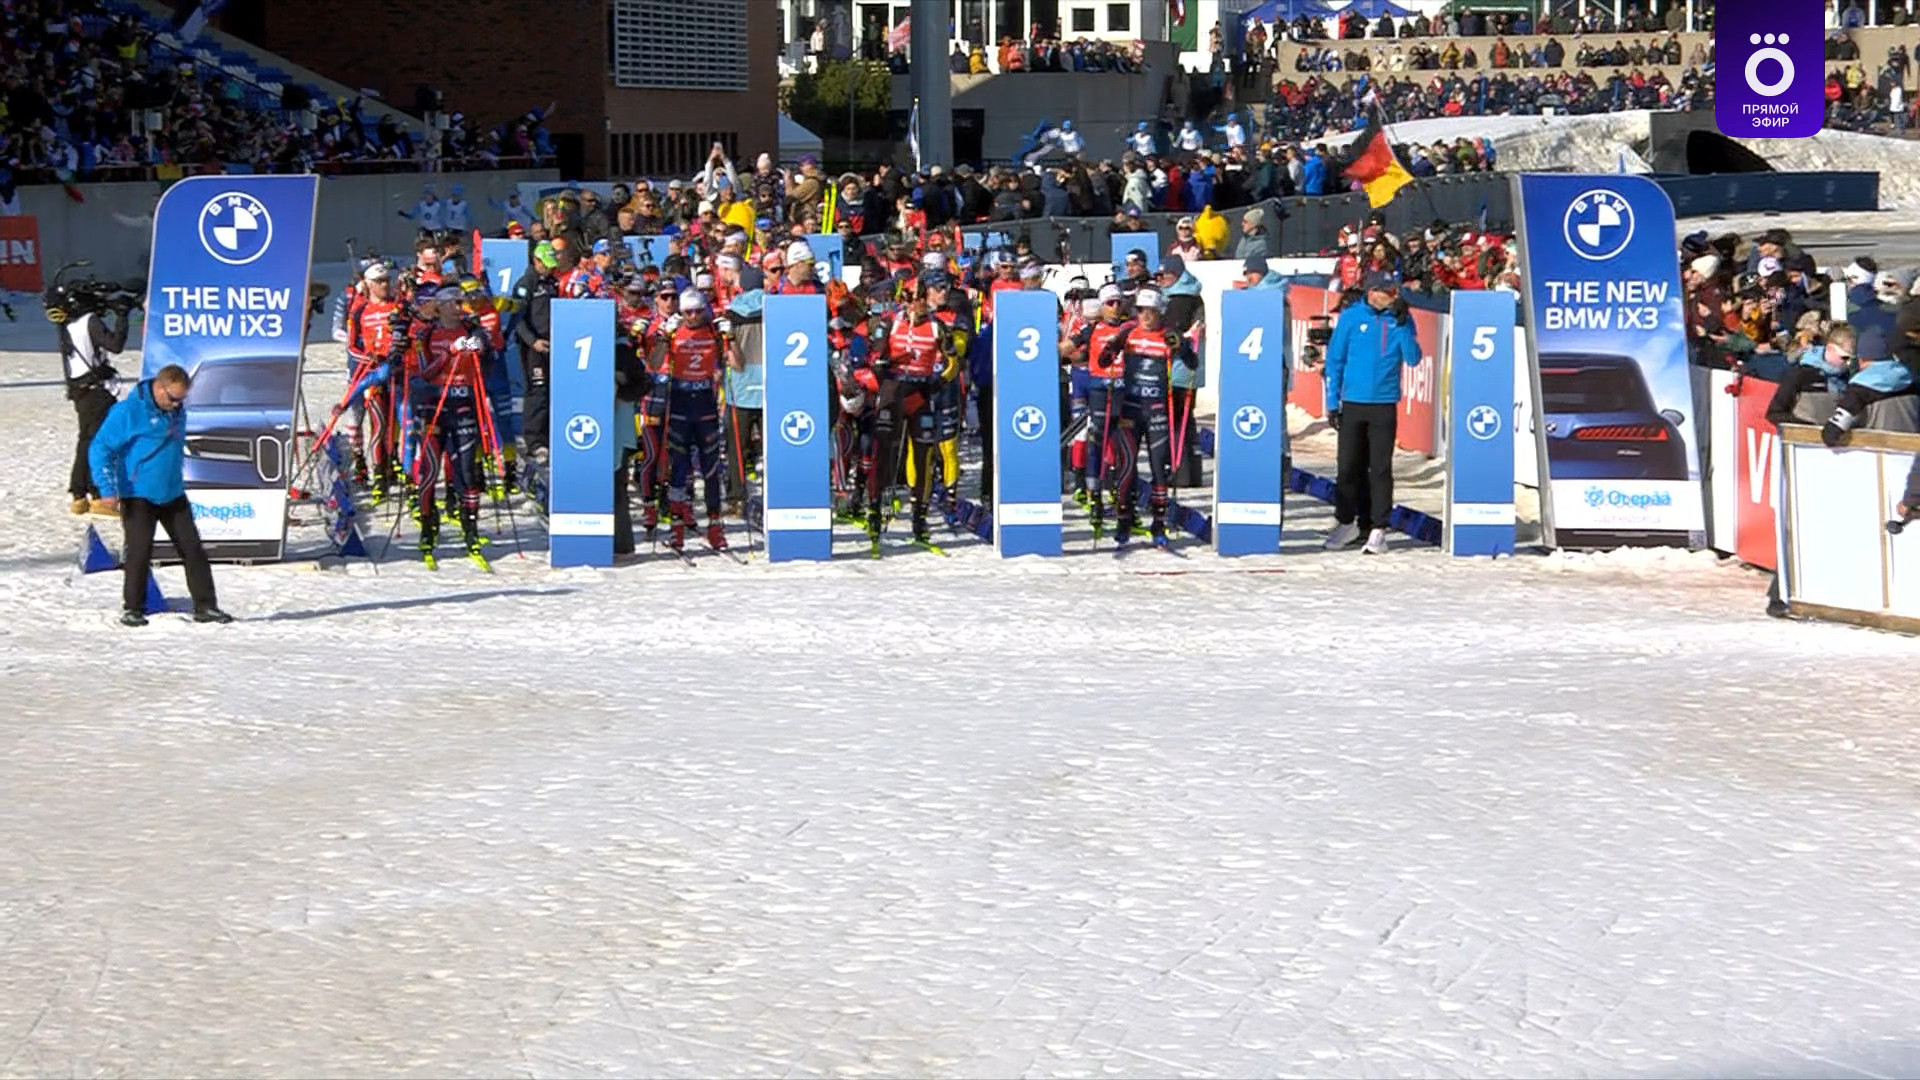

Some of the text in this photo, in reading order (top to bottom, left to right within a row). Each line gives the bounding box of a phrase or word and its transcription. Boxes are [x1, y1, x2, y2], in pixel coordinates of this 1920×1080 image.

[209, 196, 262, 217] BMW
[1574, 193, 1627, 215] BMW
[498, 267, 512, 293] 1
[1545, 281, 1668, 303] THE NEW
[162, 287, 291, 310] THE NEW
[164, 313, 283, 337] BMW iX3
[1545, 306, 1659, 330] BMW iX3
[574, 335, 593, 370] 1
[783, 331, 810, 367] 2
[1014, 327, 1041, 362] 3
[1238, 326, 1264, 361] 4
[1470, 325, 1498, 361] 5
[689, 353, 704, 369] 2
